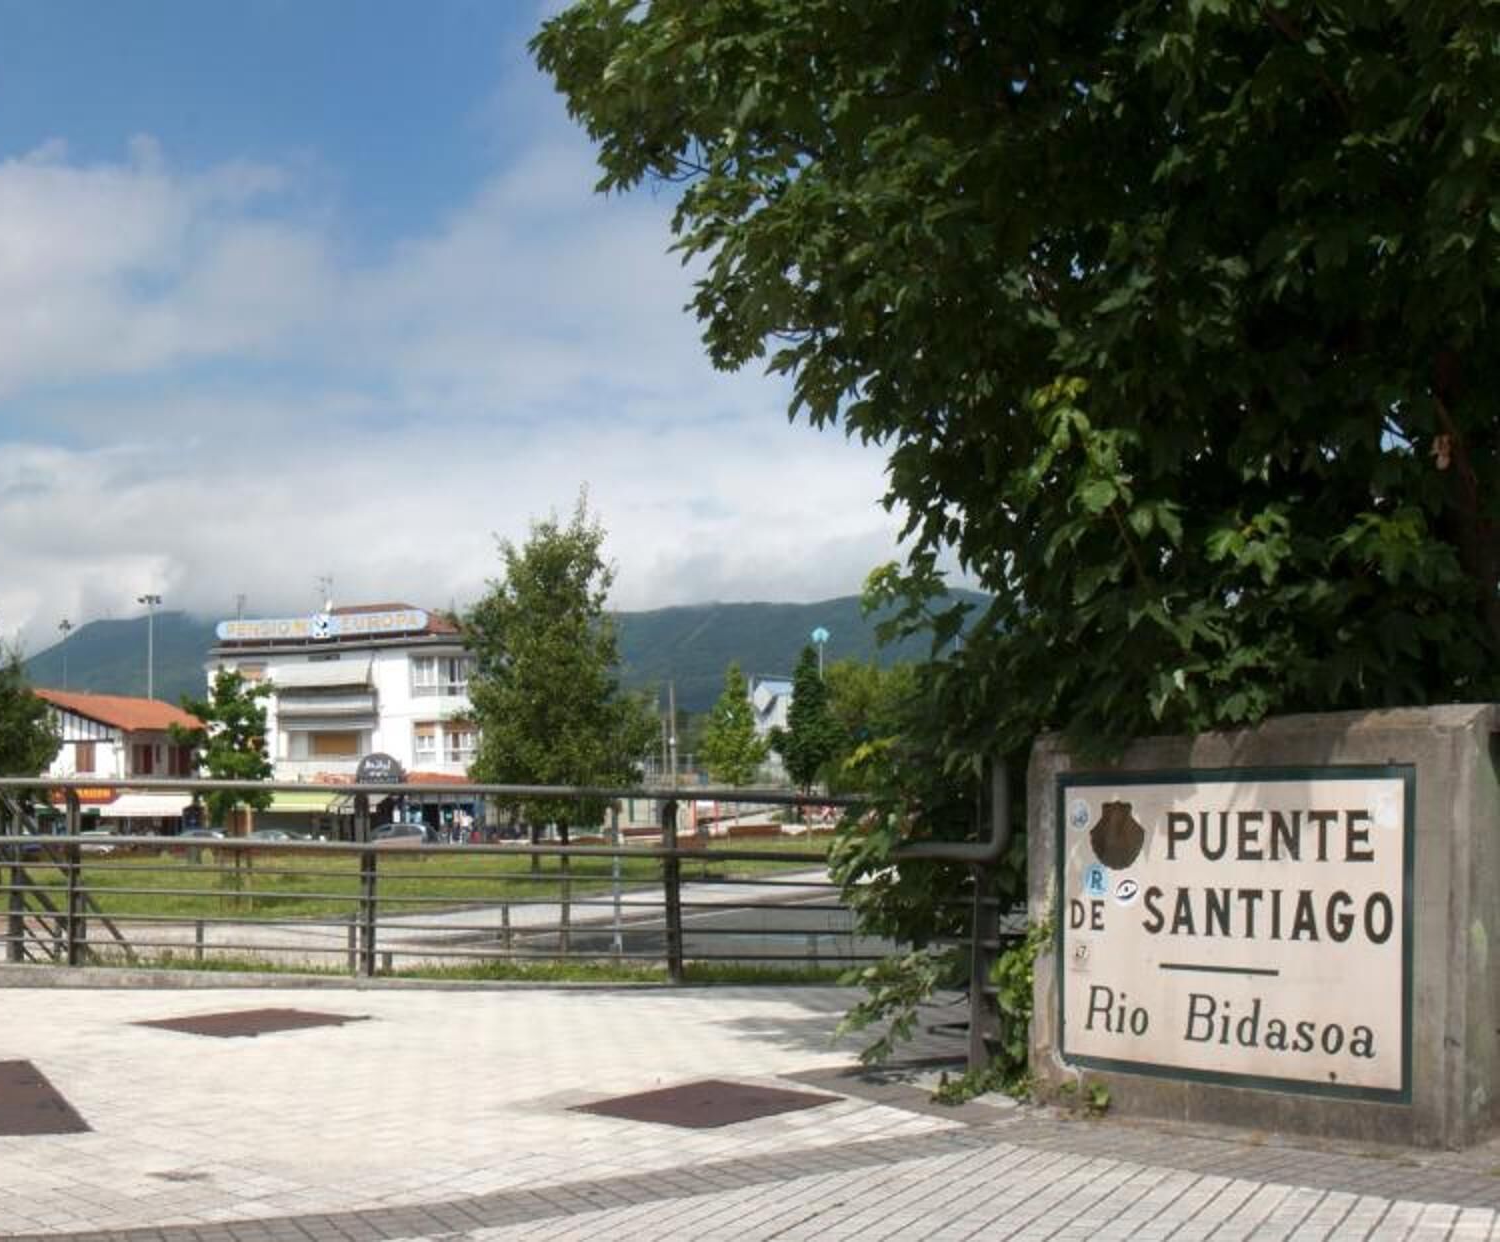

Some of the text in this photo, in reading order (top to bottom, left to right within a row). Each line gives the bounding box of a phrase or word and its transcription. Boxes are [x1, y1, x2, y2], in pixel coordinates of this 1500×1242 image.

[1165, 809, 1376, 862] PUENTE
[1069, 886, 1394, 945] DE SANTIAGO
[1085, 985, 1377, 1059] Rio Bidasoa
